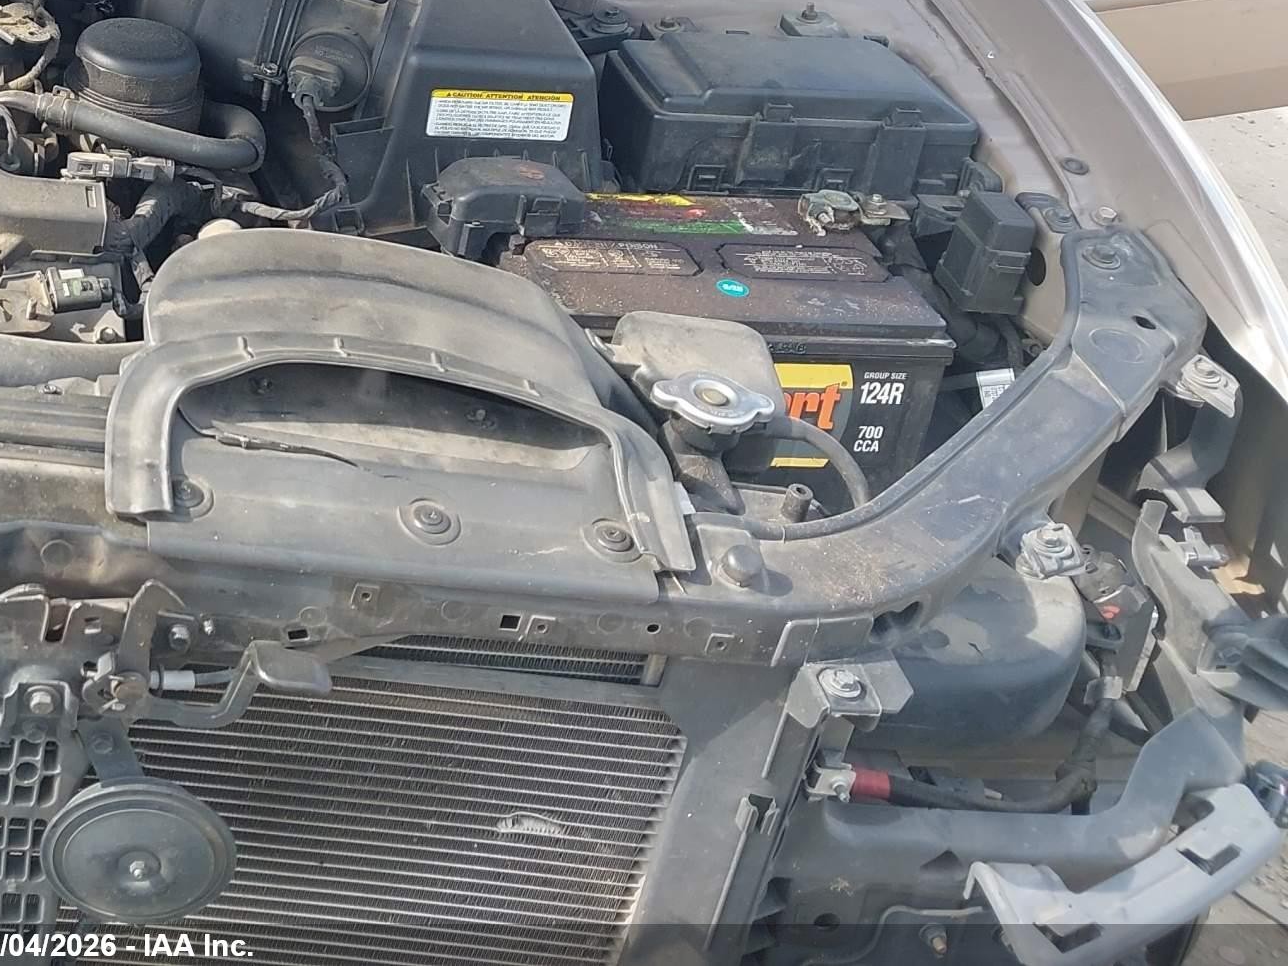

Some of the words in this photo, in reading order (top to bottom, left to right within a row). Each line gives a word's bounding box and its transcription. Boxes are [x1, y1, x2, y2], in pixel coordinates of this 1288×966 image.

[452, 91, 483, 99] CAUTION
[864, 371, 890, 380] GROUP
[890, 372, 908, 380] SIZE
[860, 381, 905, 405] 124R
[857, 425, 884, 439] 700
[853, 439, 880, 453] CCA
